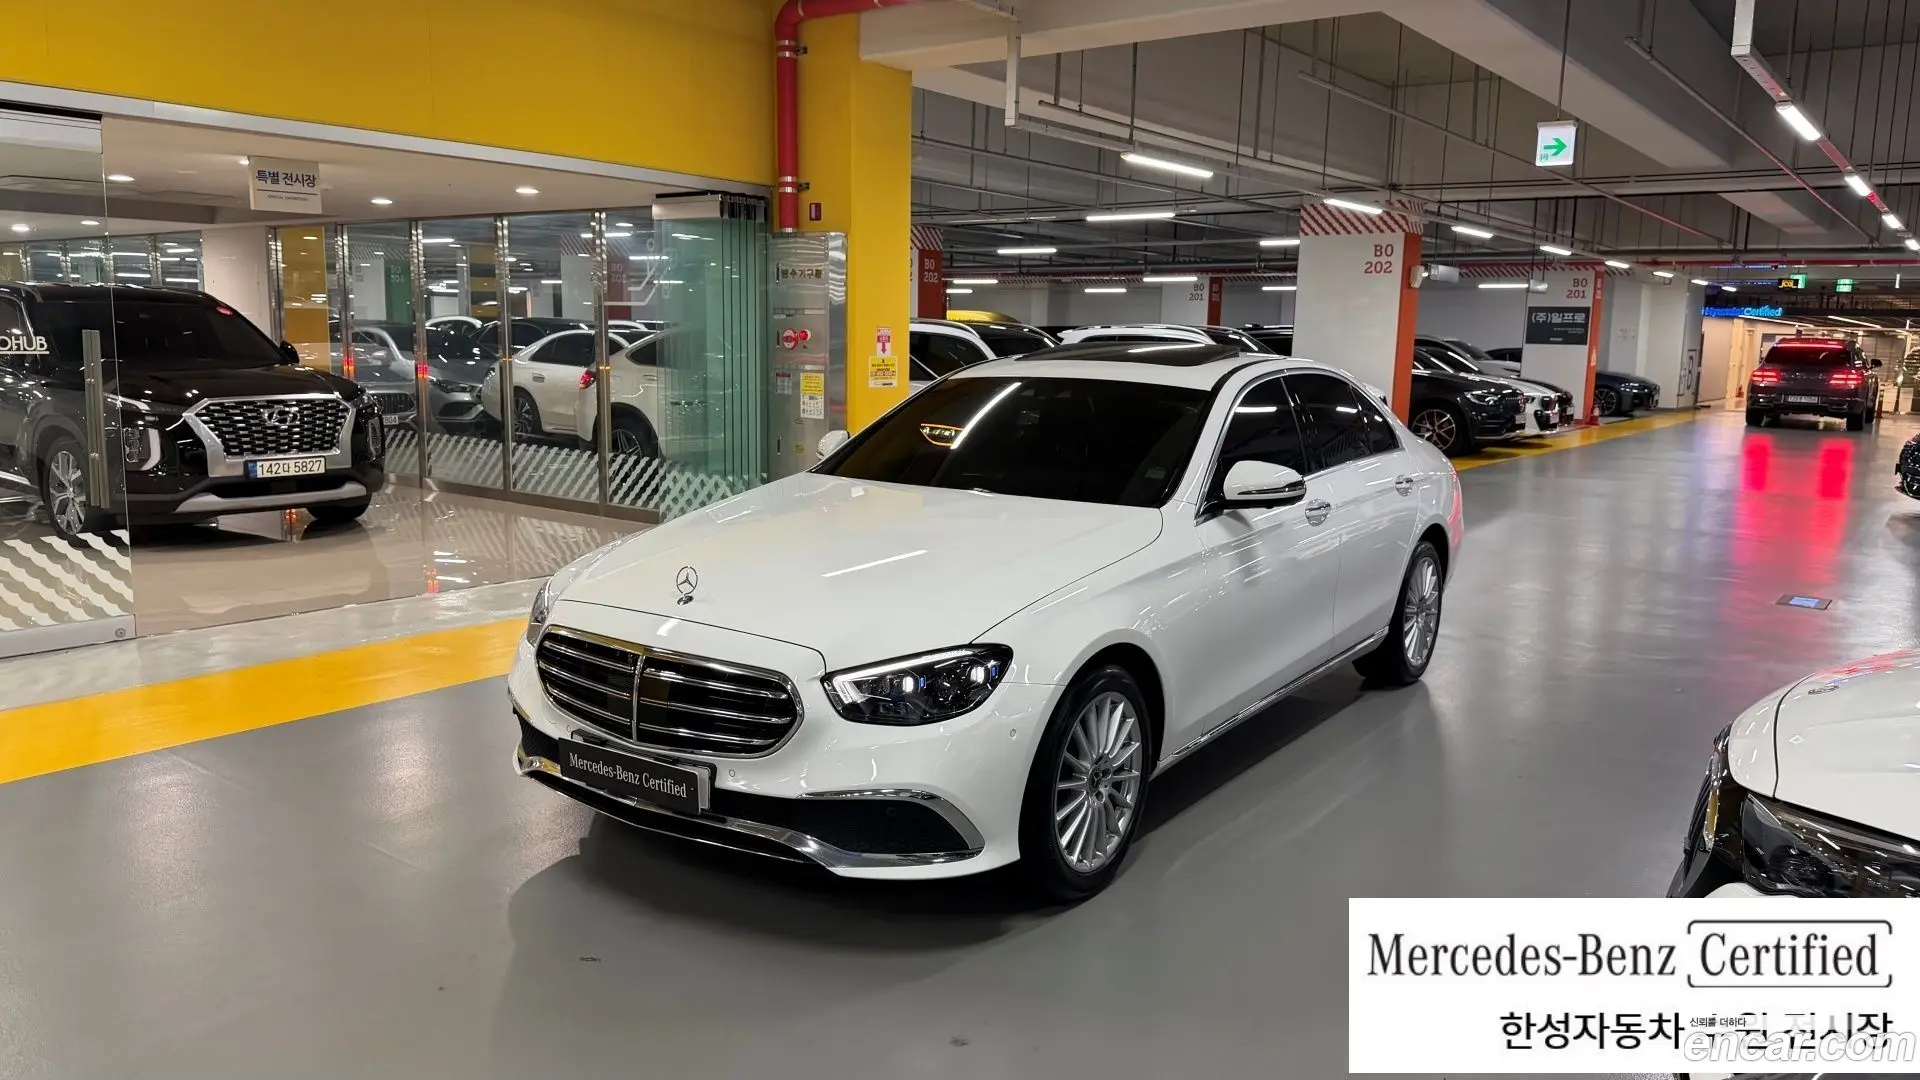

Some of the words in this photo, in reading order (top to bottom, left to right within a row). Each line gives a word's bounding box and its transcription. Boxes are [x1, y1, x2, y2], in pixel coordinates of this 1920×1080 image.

[256, 169, 280, 185] 특별
[282, 172, 317, 188] 전시장
[1364, 260, 1393, 274] 202
[923, 271, 939, 283] 202
[1566, 288, 1588, 300] 201
[294, 459, 322, 474] 5827
[569, 752, 640, 786] Mercedes-Benz
[642, 772, 687, 798] Certified
